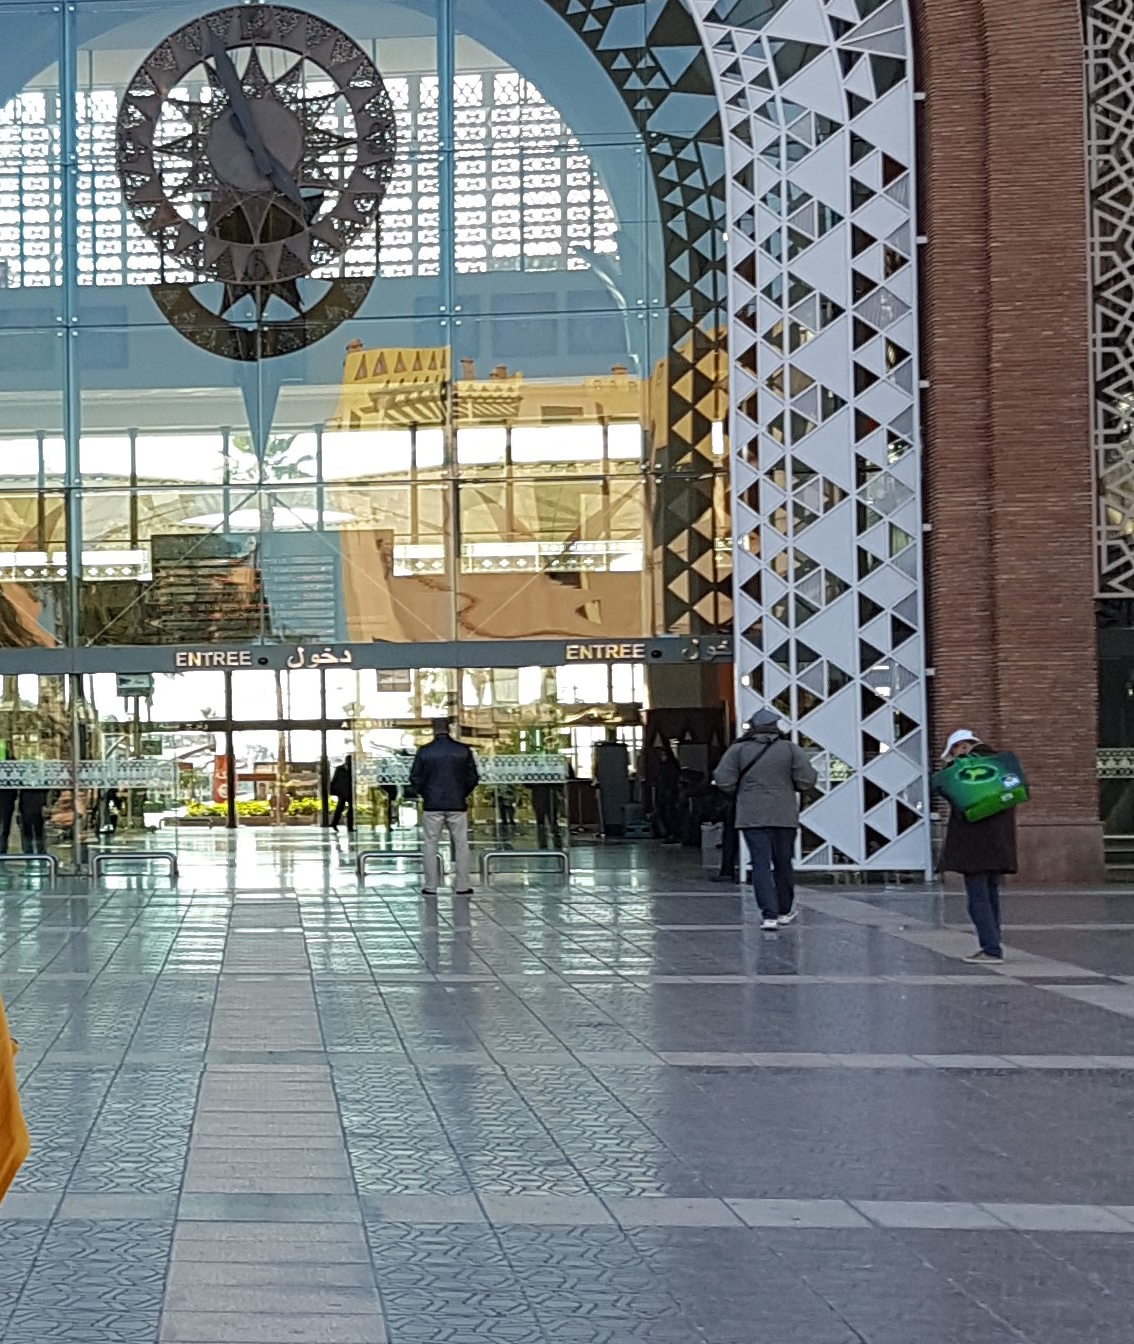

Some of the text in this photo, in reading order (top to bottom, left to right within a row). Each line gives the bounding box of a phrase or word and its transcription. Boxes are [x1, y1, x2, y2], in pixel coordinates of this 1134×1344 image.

[175, 650, 253, 667] ENTREE
[287, 646, 353, 668] دخول
[566, 643, 645, 660] ENTREE
[681, 638, 733, 661] خول
